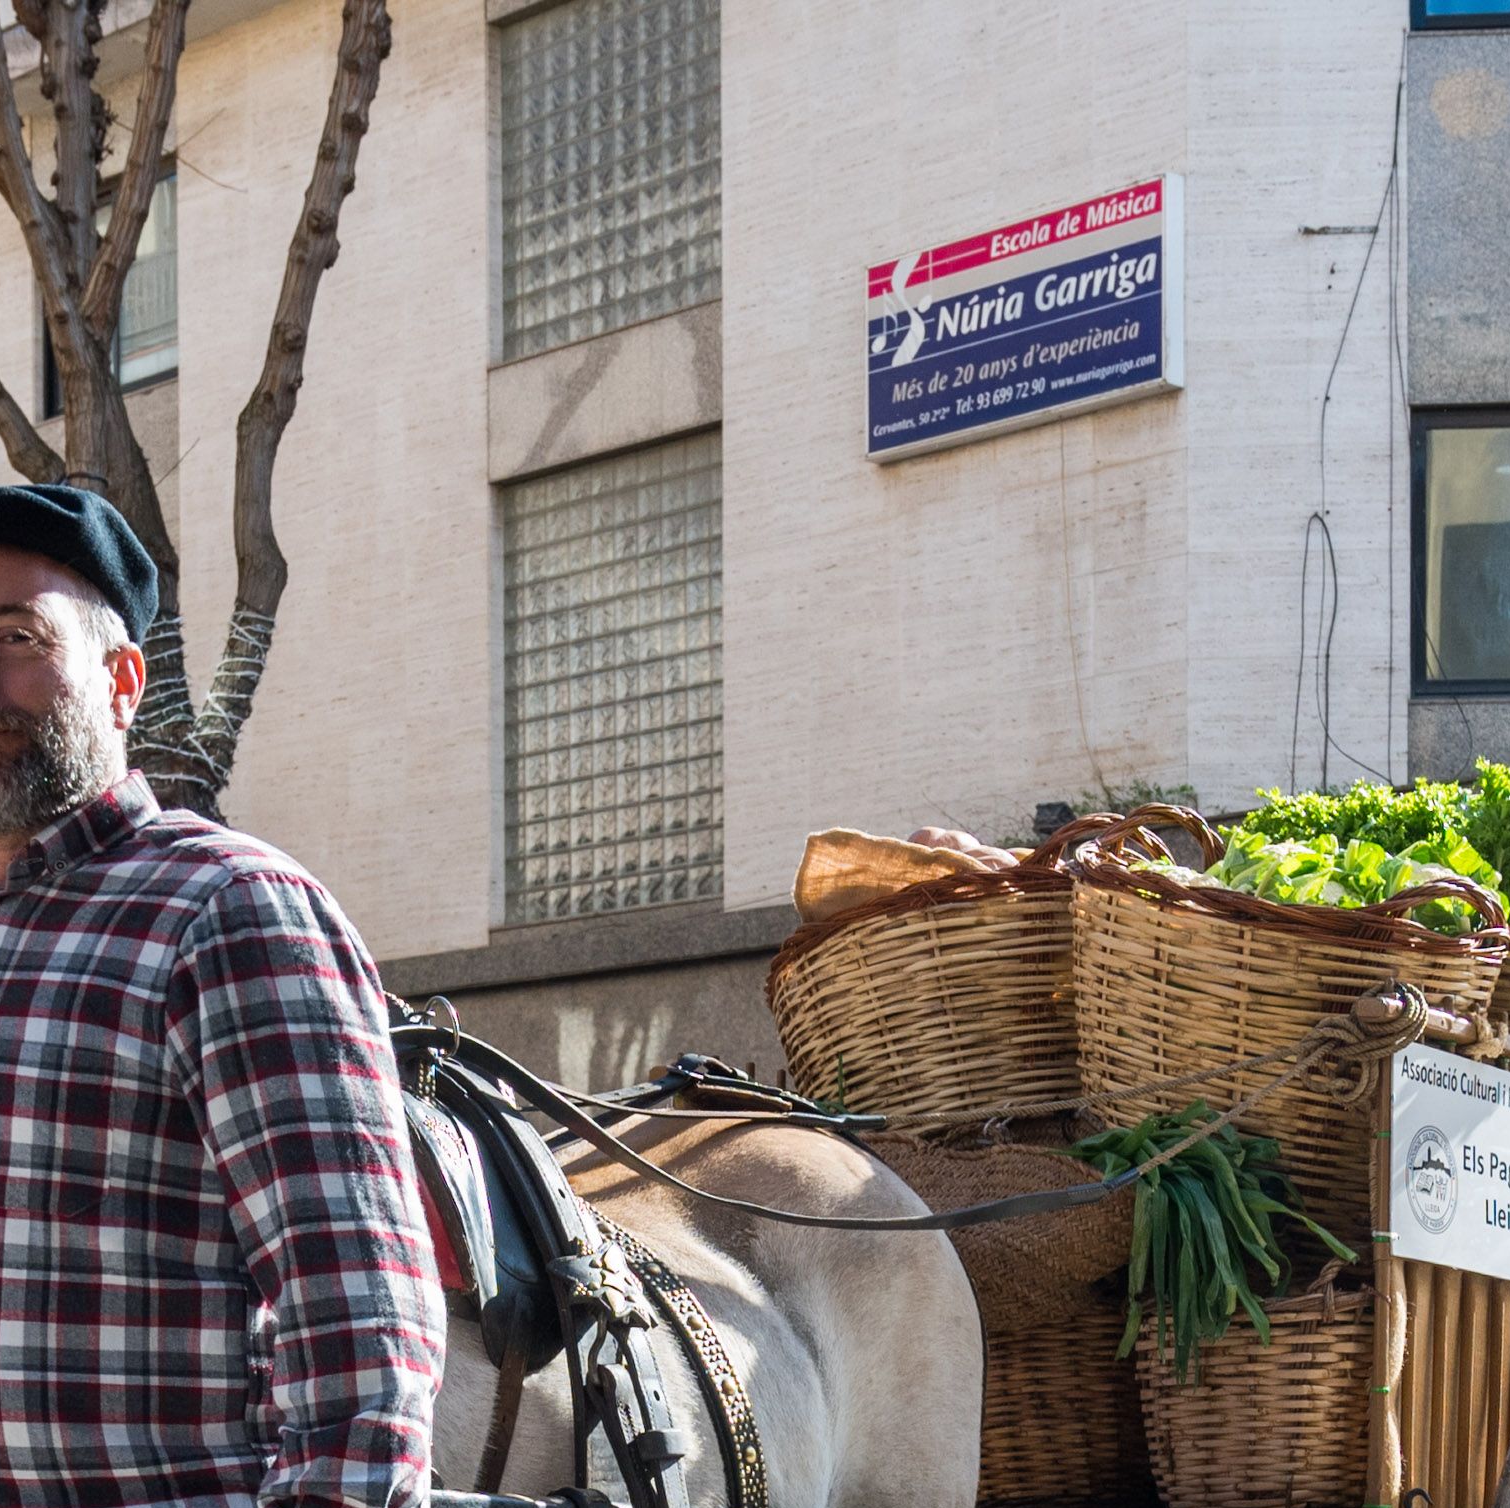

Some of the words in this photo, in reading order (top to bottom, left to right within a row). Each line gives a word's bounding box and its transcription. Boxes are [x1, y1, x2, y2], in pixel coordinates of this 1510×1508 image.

[990, 223, 1050, 259] Escola
[1056, 211, 1079, 237] de
[1086, 189, 1157, 229] Música
[936, 286, 1024, 342] Núria
[1035, 252, 1157, 312] Garriga
[892, 376, 923, 404] Més
[928, 370, 947, 394] de
[953, 366, 974, 390] 20
[979, 355, 1018, 383] anys
[919, 412, 930, 426] 50
[956, 395, 973, 415] Tel:
[977, 391, 990, 410] 93
[993, 385, 1013, 405] 699
[1016, 381, 1029, 399] 72
[1031, 377, 1046, 395] 90
[1051, 353, 1156, 390] www.nuriagarriga.com
[1401, 1055, 1457, 1092] Associació
[1460, 1072, 1501, 1104] Cultural
[1463, 1145, 1484, 1175] Els
